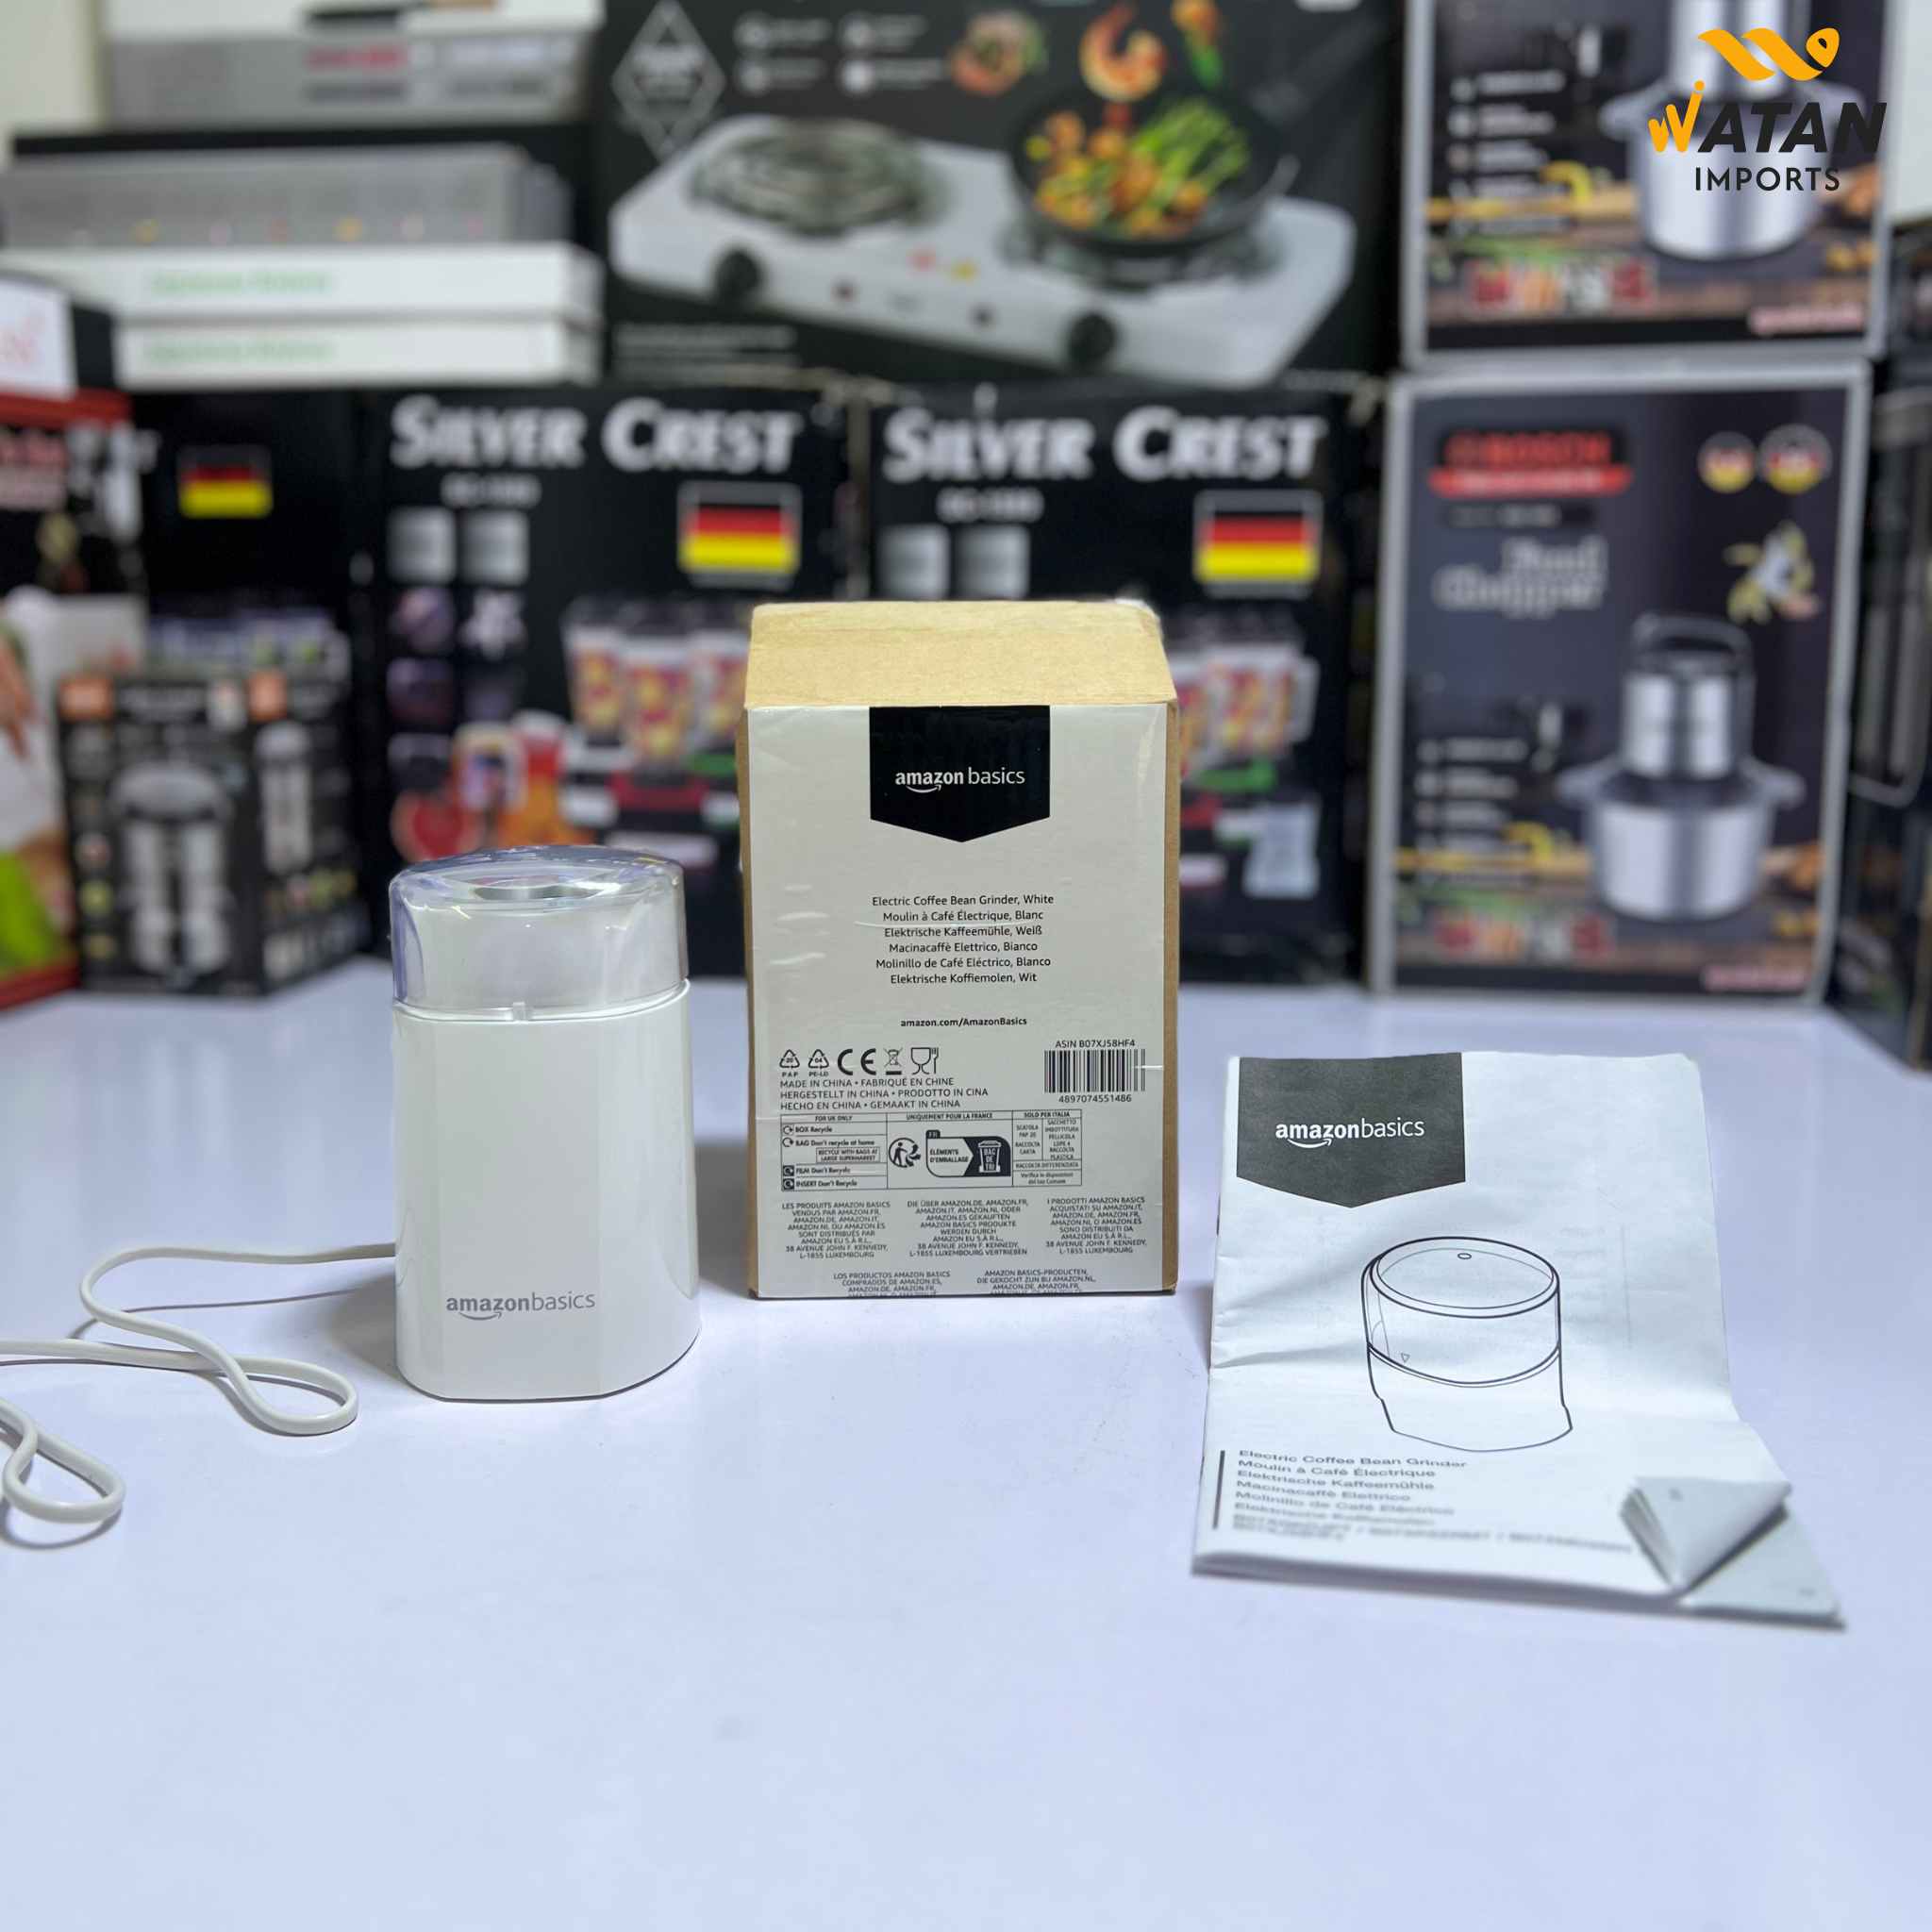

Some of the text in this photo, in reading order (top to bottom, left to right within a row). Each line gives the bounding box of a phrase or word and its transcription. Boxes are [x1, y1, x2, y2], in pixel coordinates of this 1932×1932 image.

[895, 767, 1025, 789] amazon basics
[873, 894, 1054, 906] Electric Coffee Bean Grinder, White
[883, 909, 1043, 923] Moulin à Café Électrique, Blanc
[885, 925, 1041, 938] Elektrische Kaffeemühle, Weiß
[890, 941, 1038, 953] Macinacaffè Elettrico, Bianco
[876, 958, 1051, 969] Molinillo de Café Eléctrico, Blanco
[891, 973, 1037, 984] Elektrische Koffiemolen, Wit
[901, 1016, 1027, 1027] amazon.com/AmazonBasics
[1079, 1040, 1136, 1048] B07XJ58HF4
[780, 1080, 808, 1089] MADE
[810, 1079, 820, 1088] IN
[823, 1079, 852, 1088] CHINA
[924, 1077, 954, 1086] CHINE
[780, 1091, 844, 1100] HERGESTELLT
[847, 1090, 857, 1098] IN
[859, 1090, 890, 1098] CHINA
[898, 1089, 951, 1098] PRODOTTO
[1058, 1094, 1132, 1103] 4897074551486
[780, 1102, 814, 1110] HECHO
[832, 1101, 861, 1109] CHINA
[871, 1100, 915, 1109] GEMAAKT
[918, 1100, 927, 1108] IN
[930, 1100, 960, 1108] CHINA
[1275, 1117, 1424, 1141] amazonbasics
[446, 1291, 596, 1315] amazonbasics
[1240, 1450, 1297, 1463] Electric
[1303, 1456, 1355, 1465] Coffee
[1407, 1457, 1467, 1468] Grinder
[1239, 1460, 1291, 1473] Moulin
